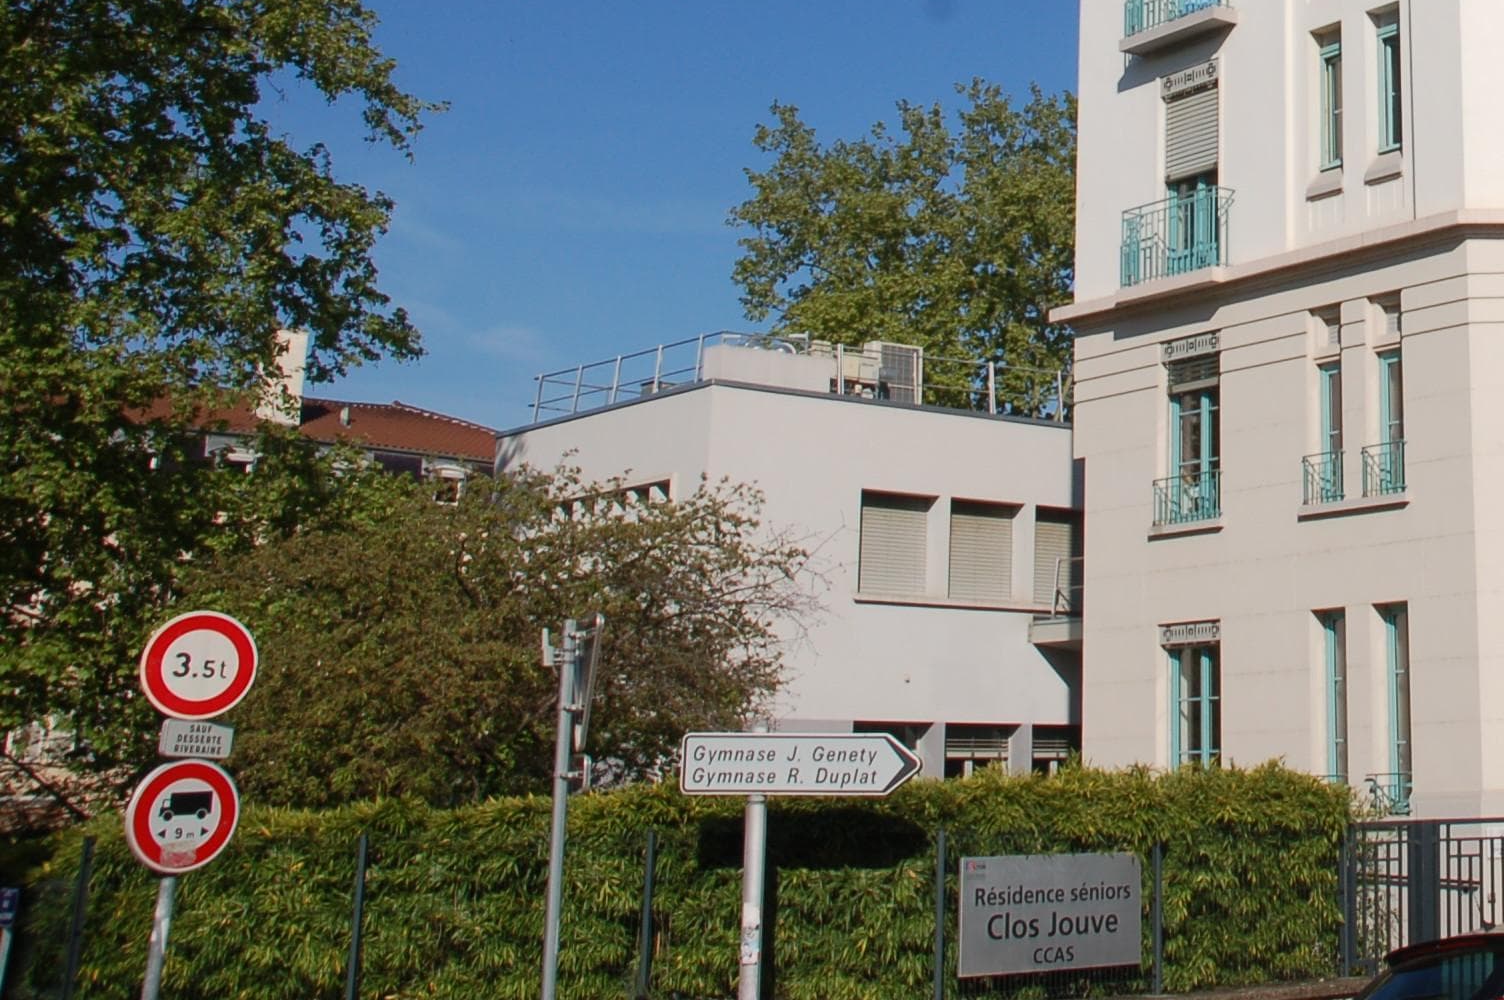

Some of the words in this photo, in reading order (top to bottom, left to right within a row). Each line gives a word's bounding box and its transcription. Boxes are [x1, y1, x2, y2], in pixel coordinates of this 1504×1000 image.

[189, 724, 212, 733] SAUF
[177, 733, 223, 745] DESSERTE
[173, 744, 223, 755] RIVERAINE
[693, 745, 776, 765] Gymnase
[786, 745, 801, 762] J.
[812, 745, 878, 766] Genety
[692, 767, 776, 787] Gymnase
[787, 767, 803, 784] R.
[815, 767, 878, 789] Duplat
[974, 884, 1065, 907] Résidence
[1070, 881, 1132, 901] séniors
[987, 911, 1040, 940] Clos
[1047, 911, 1119, 937] Jouve
[1033, 945, 1075, 964] CCAS
